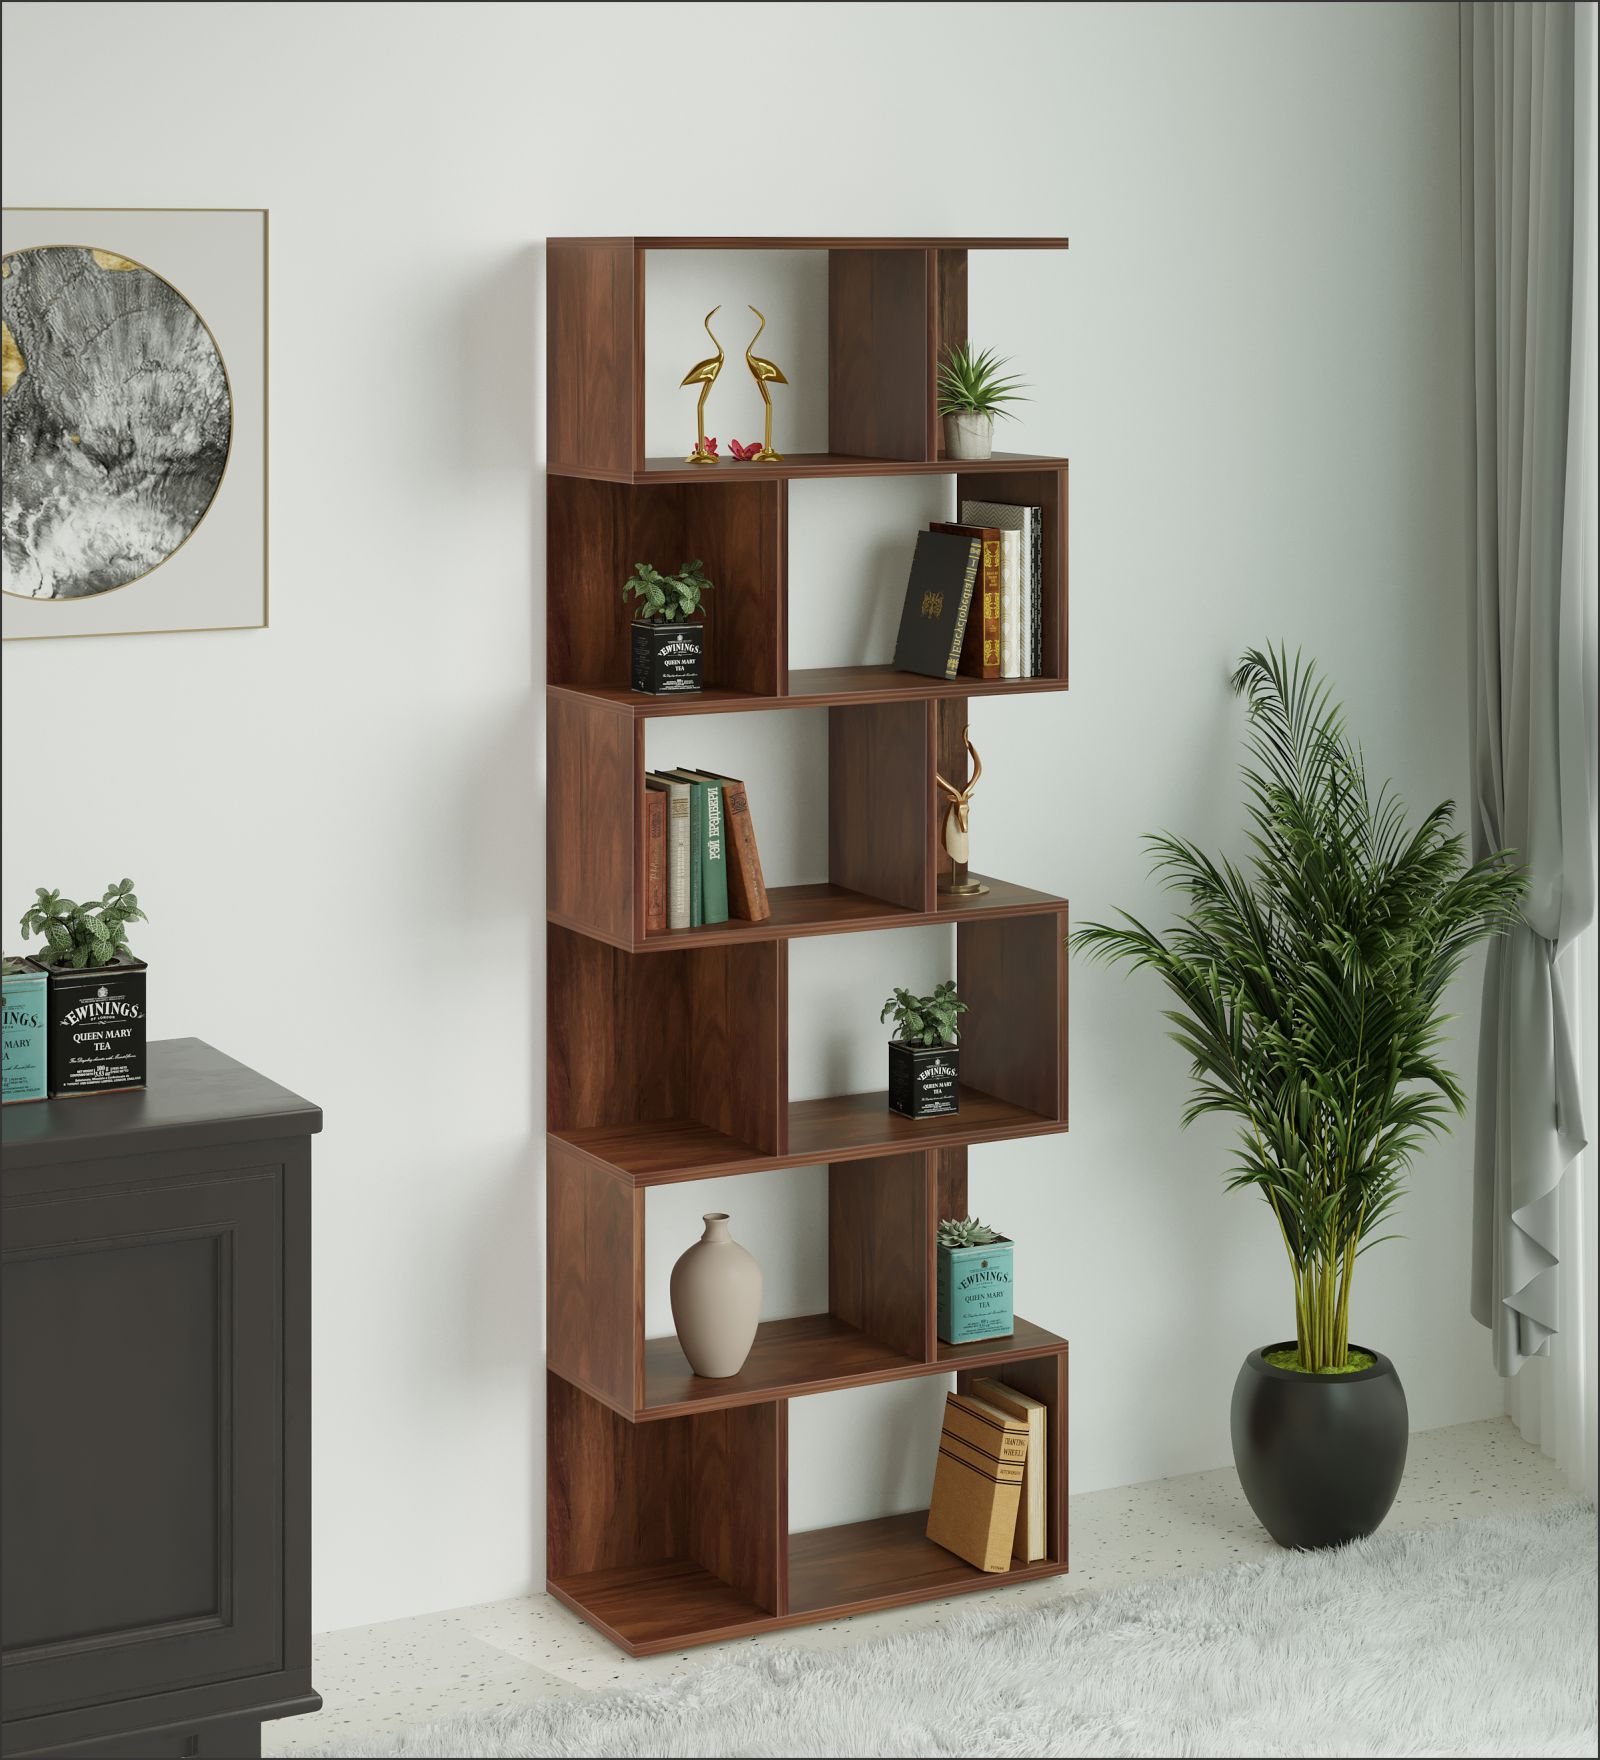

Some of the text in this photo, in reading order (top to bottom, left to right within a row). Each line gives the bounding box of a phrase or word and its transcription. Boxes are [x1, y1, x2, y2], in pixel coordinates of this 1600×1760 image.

[707, 786, 721, 860] РЭЙ БРЭДБЕРИ
[73, 1028, 132, 1043] QUEEN MARY
[4, 1039, 31, 1049] MARY
[94, 1041, 111, 1051] TEA
[964, 1290, 1004, 1304] QUEEN MARY
[979, 1301, 990, 1309] TEA
